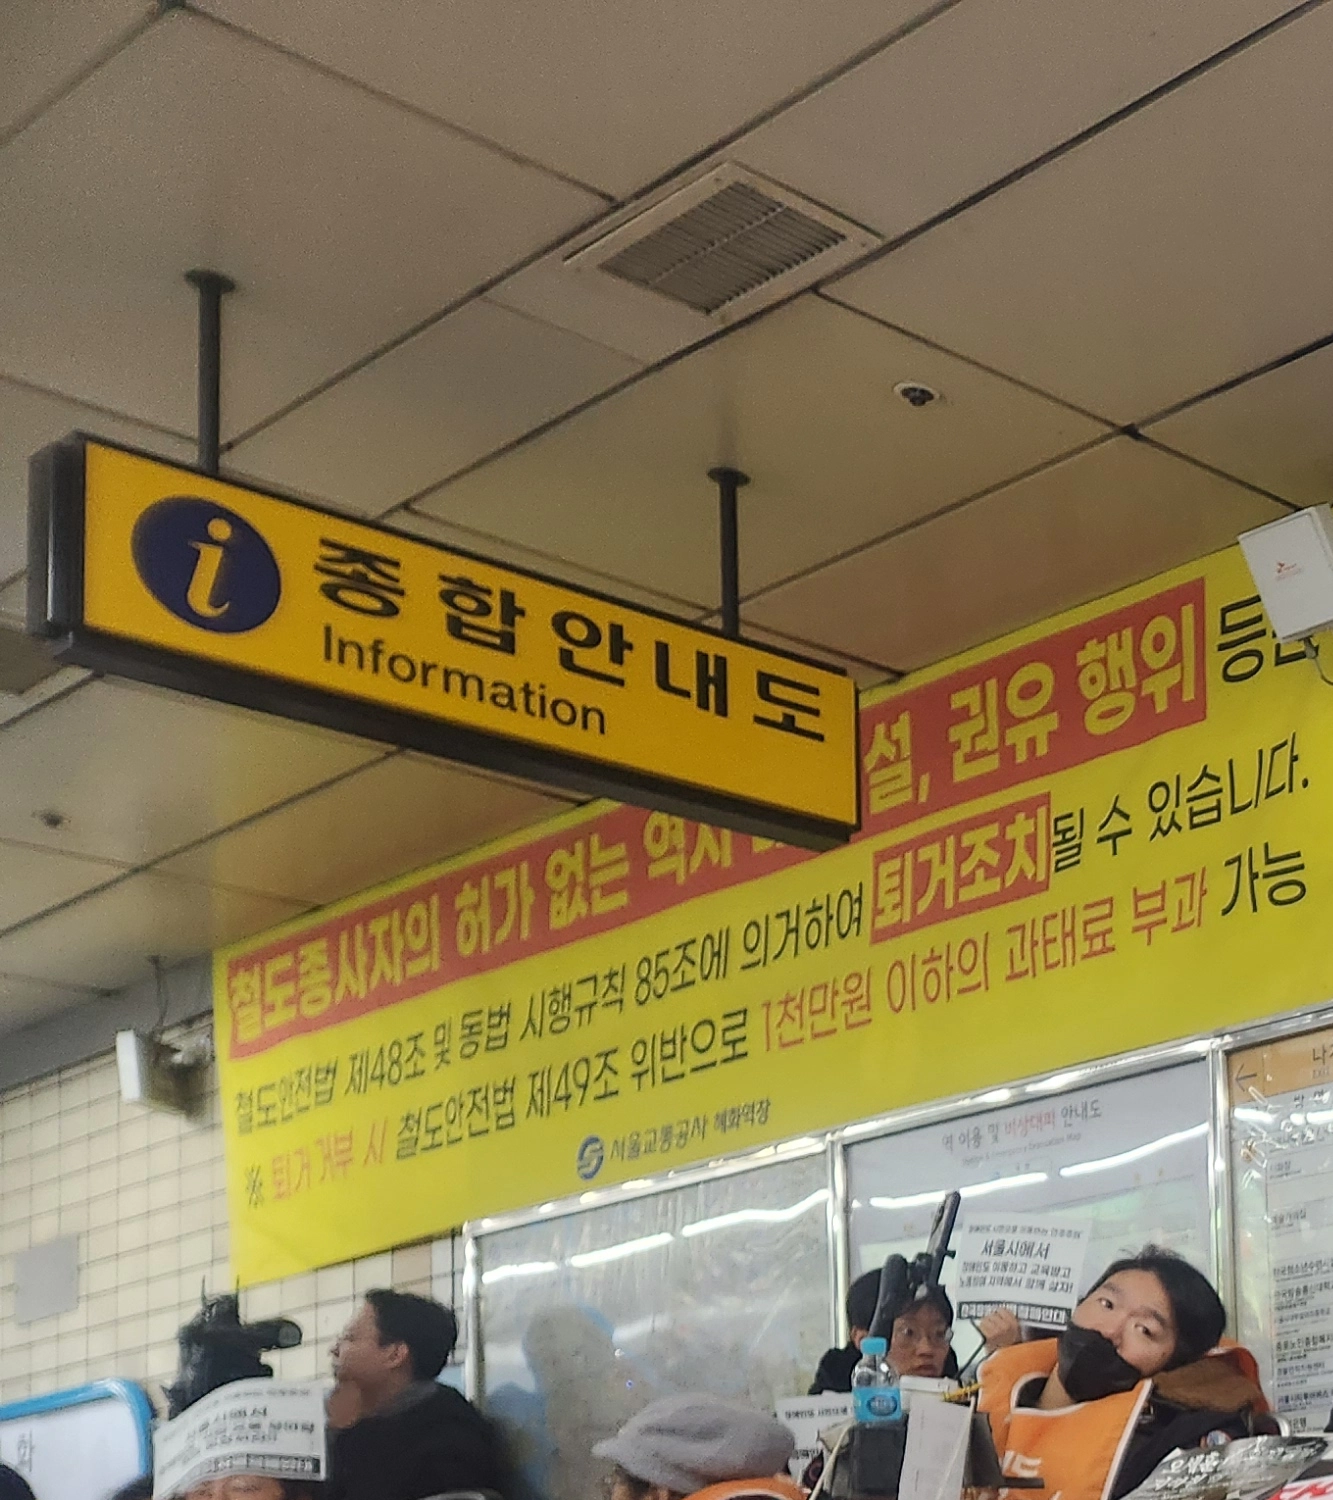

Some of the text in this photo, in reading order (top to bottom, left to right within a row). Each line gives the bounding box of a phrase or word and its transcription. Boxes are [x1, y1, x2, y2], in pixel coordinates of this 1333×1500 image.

[314, 537, 825, 743] 종합안내도
[323, 624, 606, 735] Information
[229, 890, 441, 1045] 철도종사자의
[456, 861, 535, 957] 허가
[544, 833, 630, 930] 없는
[949, 662, 1060, 780] 권유
[1076, 605, 1197, 735] 행위
[236, 1065, 338, 1134] 철도안전법
[344, 1030, 425, 1094] 제48조
[434, 1020, 452, 1067] 및
[460, 1000, 512, 1056] 동법
[521, 962, 626, 1040] 시행규칙
[634, 926, 729, 1006] 85조에
[740, 881, 863, 970] 의거하여
[1095, 793, 1132, 857] 수
[1148, 730, 1309, 837] 있습니다.
[270, 842, 1307, 1202] 퇴거 거부 시 철도안전법 제49조 위반으로 1천만원 이하의 과태료 부과 가능
[609, 1119, 705, 1161] 서울교통공사
[1061, 1099, 1103, 1128] 안내도
[981, 1239, 1050, 1260] 서울시에서
